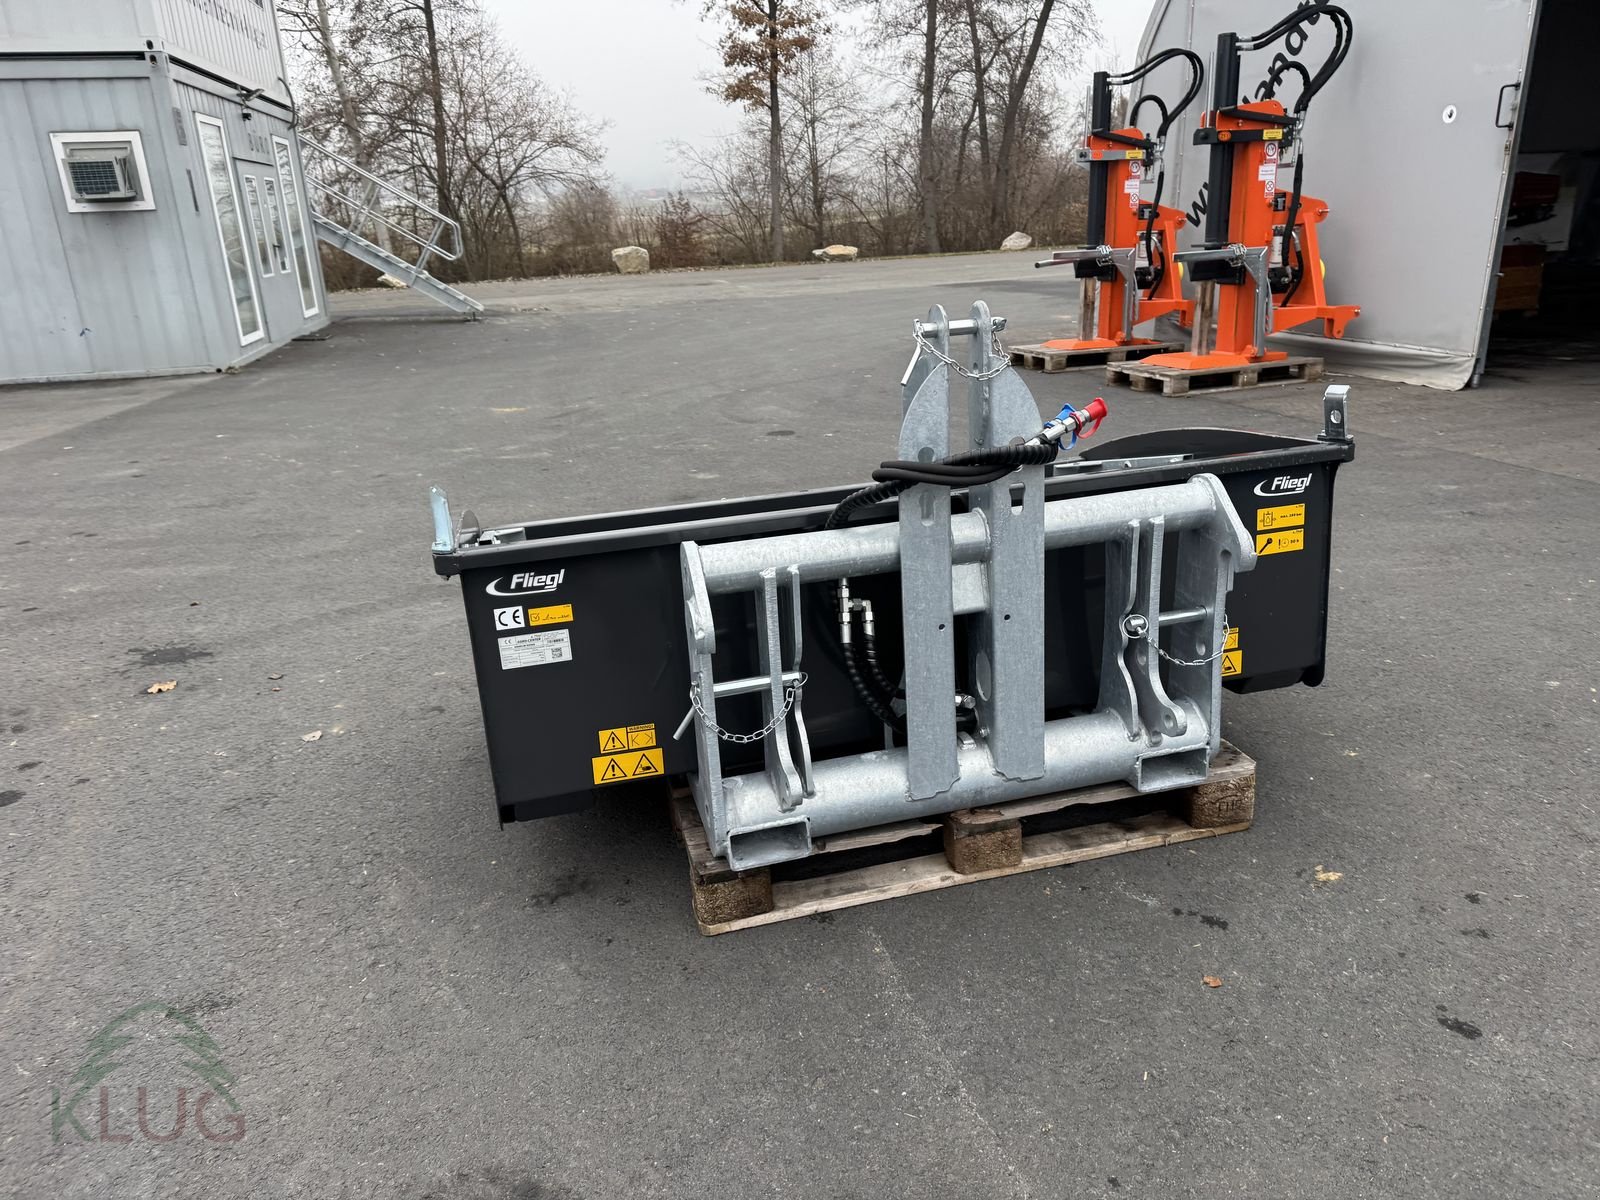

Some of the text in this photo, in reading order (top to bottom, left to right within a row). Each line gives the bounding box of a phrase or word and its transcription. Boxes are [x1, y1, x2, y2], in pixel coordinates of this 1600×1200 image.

[1271, 473, 1312, 492] Fliegl
[510, 568, 566, 590] Fliegl
[498, 608, 522, 627] CE
